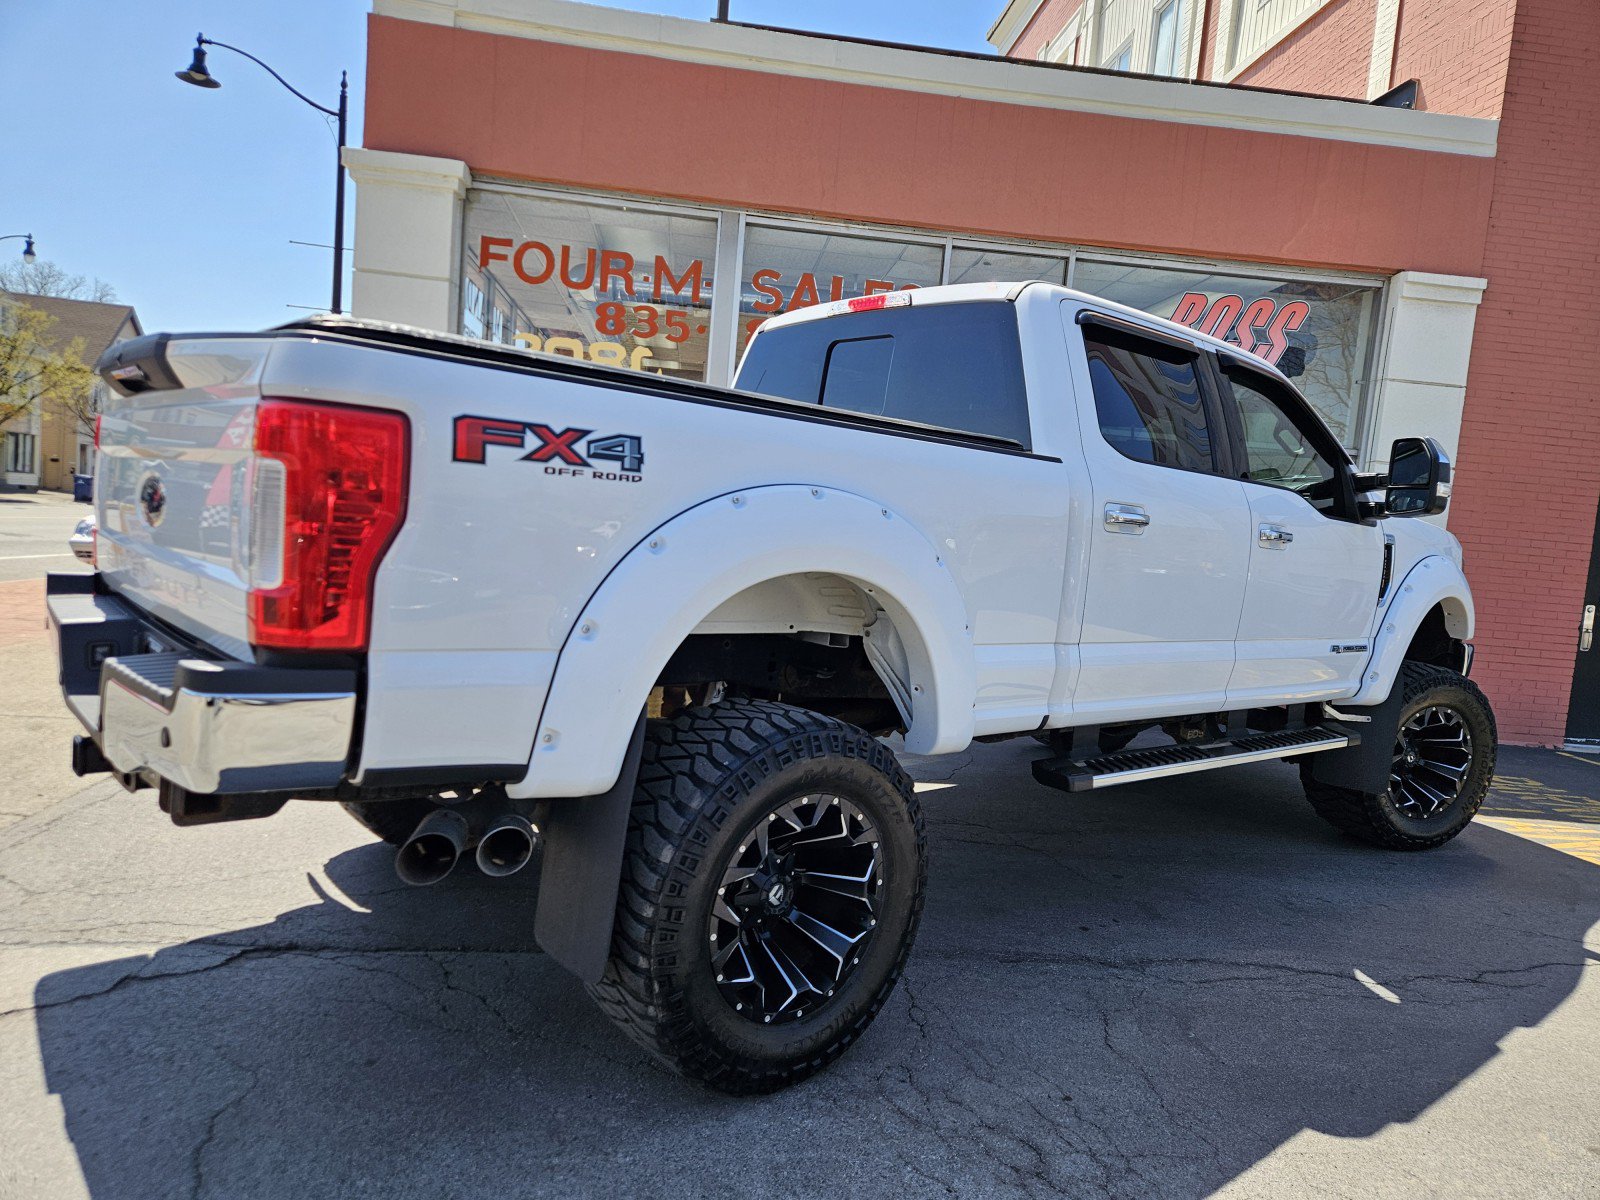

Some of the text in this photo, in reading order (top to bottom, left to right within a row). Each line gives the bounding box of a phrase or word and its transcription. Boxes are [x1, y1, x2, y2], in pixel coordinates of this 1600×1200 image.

[452, 414, 644, 472] FX4
[544, 466, 643, 483] OFF ROAD
